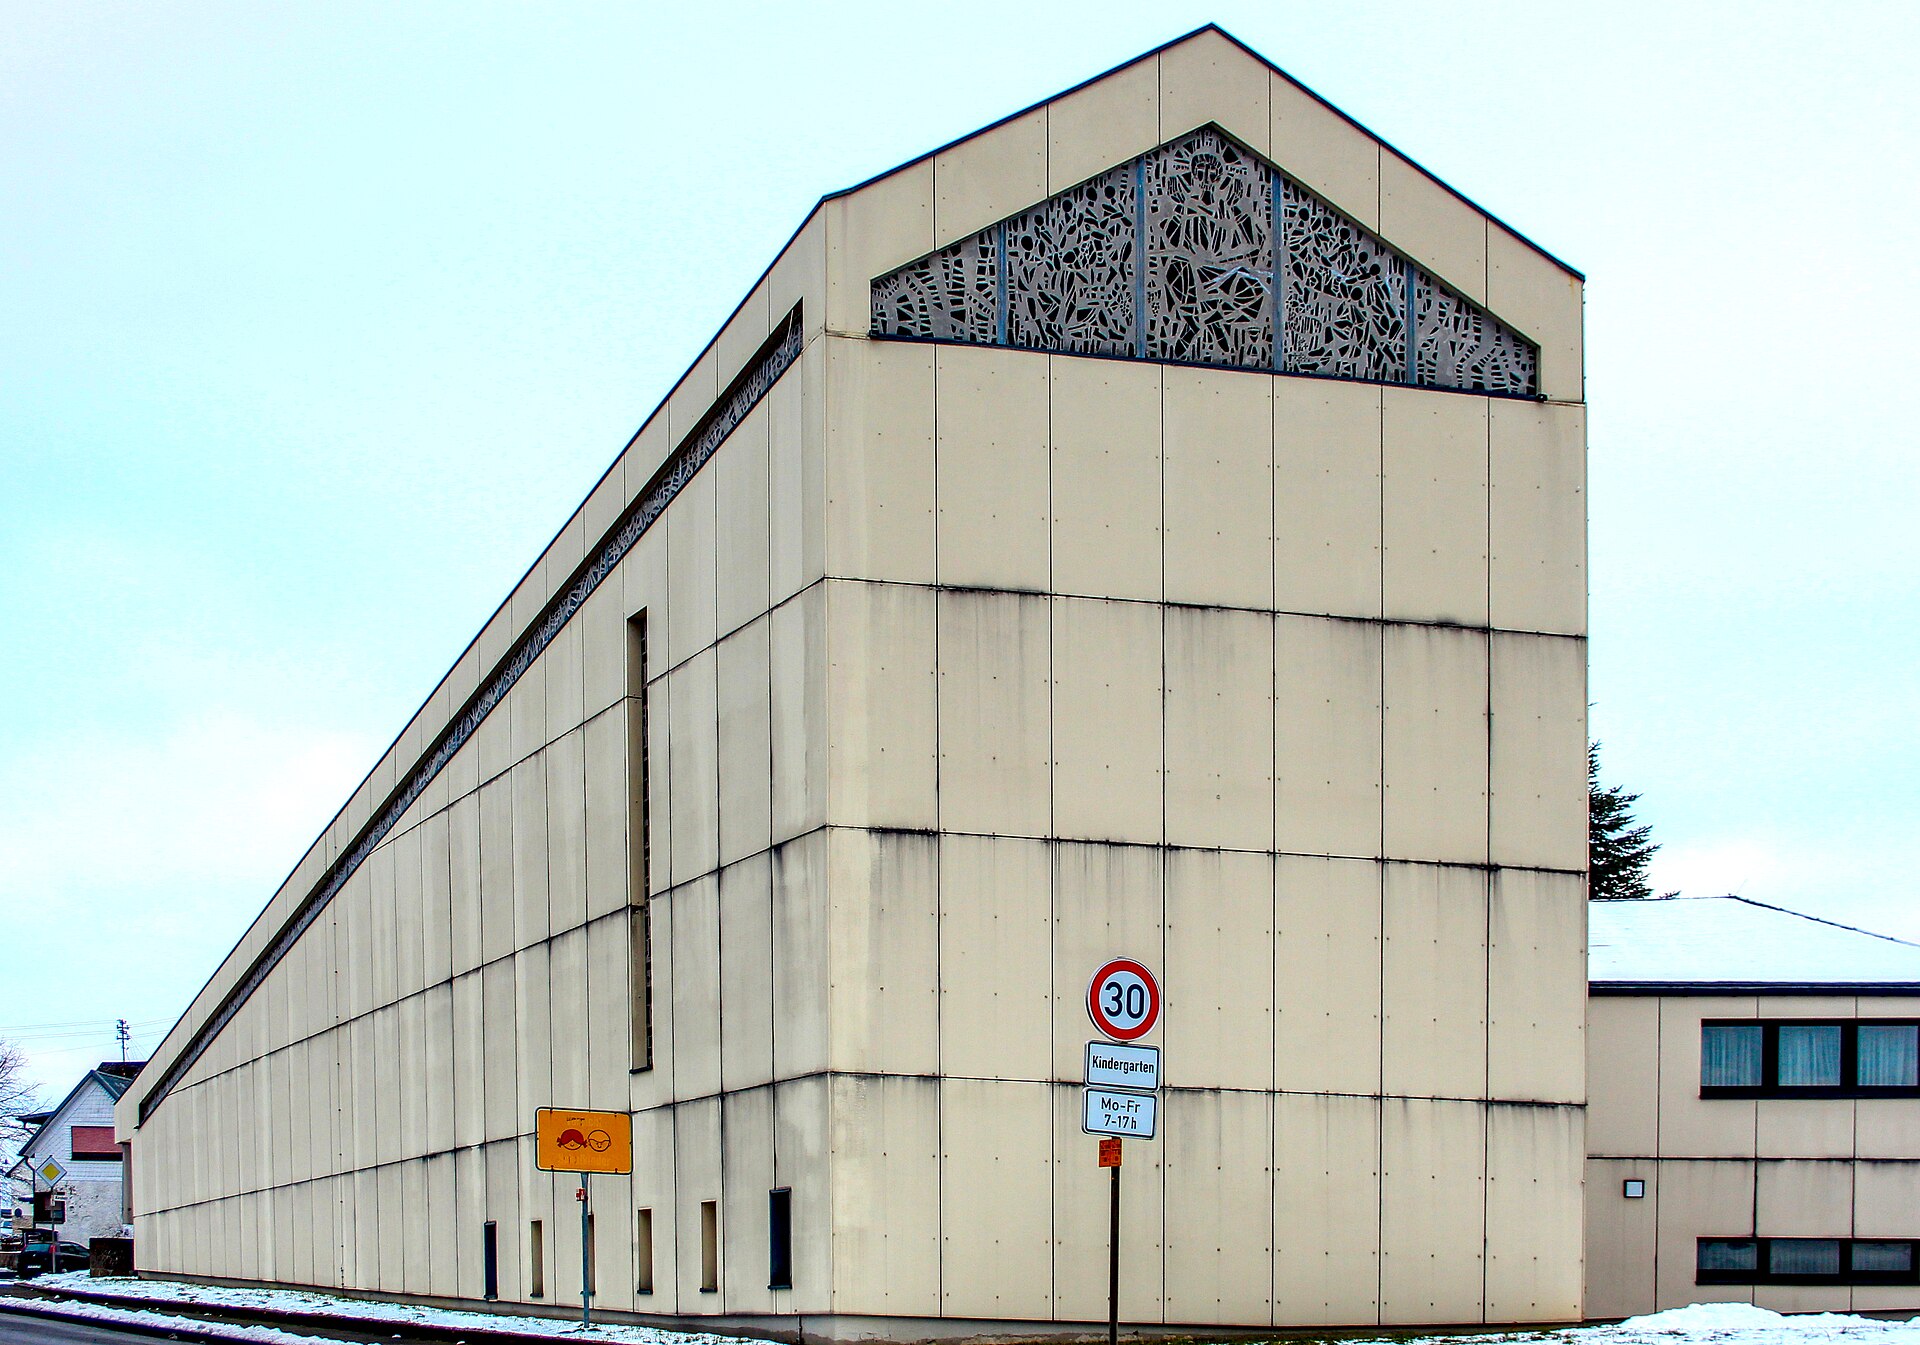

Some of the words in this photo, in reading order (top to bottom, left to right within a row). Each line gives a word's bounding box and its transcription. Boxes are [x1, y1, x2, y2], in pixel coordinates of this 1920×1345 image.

[1104, 981, 1145, 1019] 30
[1092, 1055, 1154, 1075] Kindergarten
[1101, 1097, 1141, 1113] Mo-Fr
